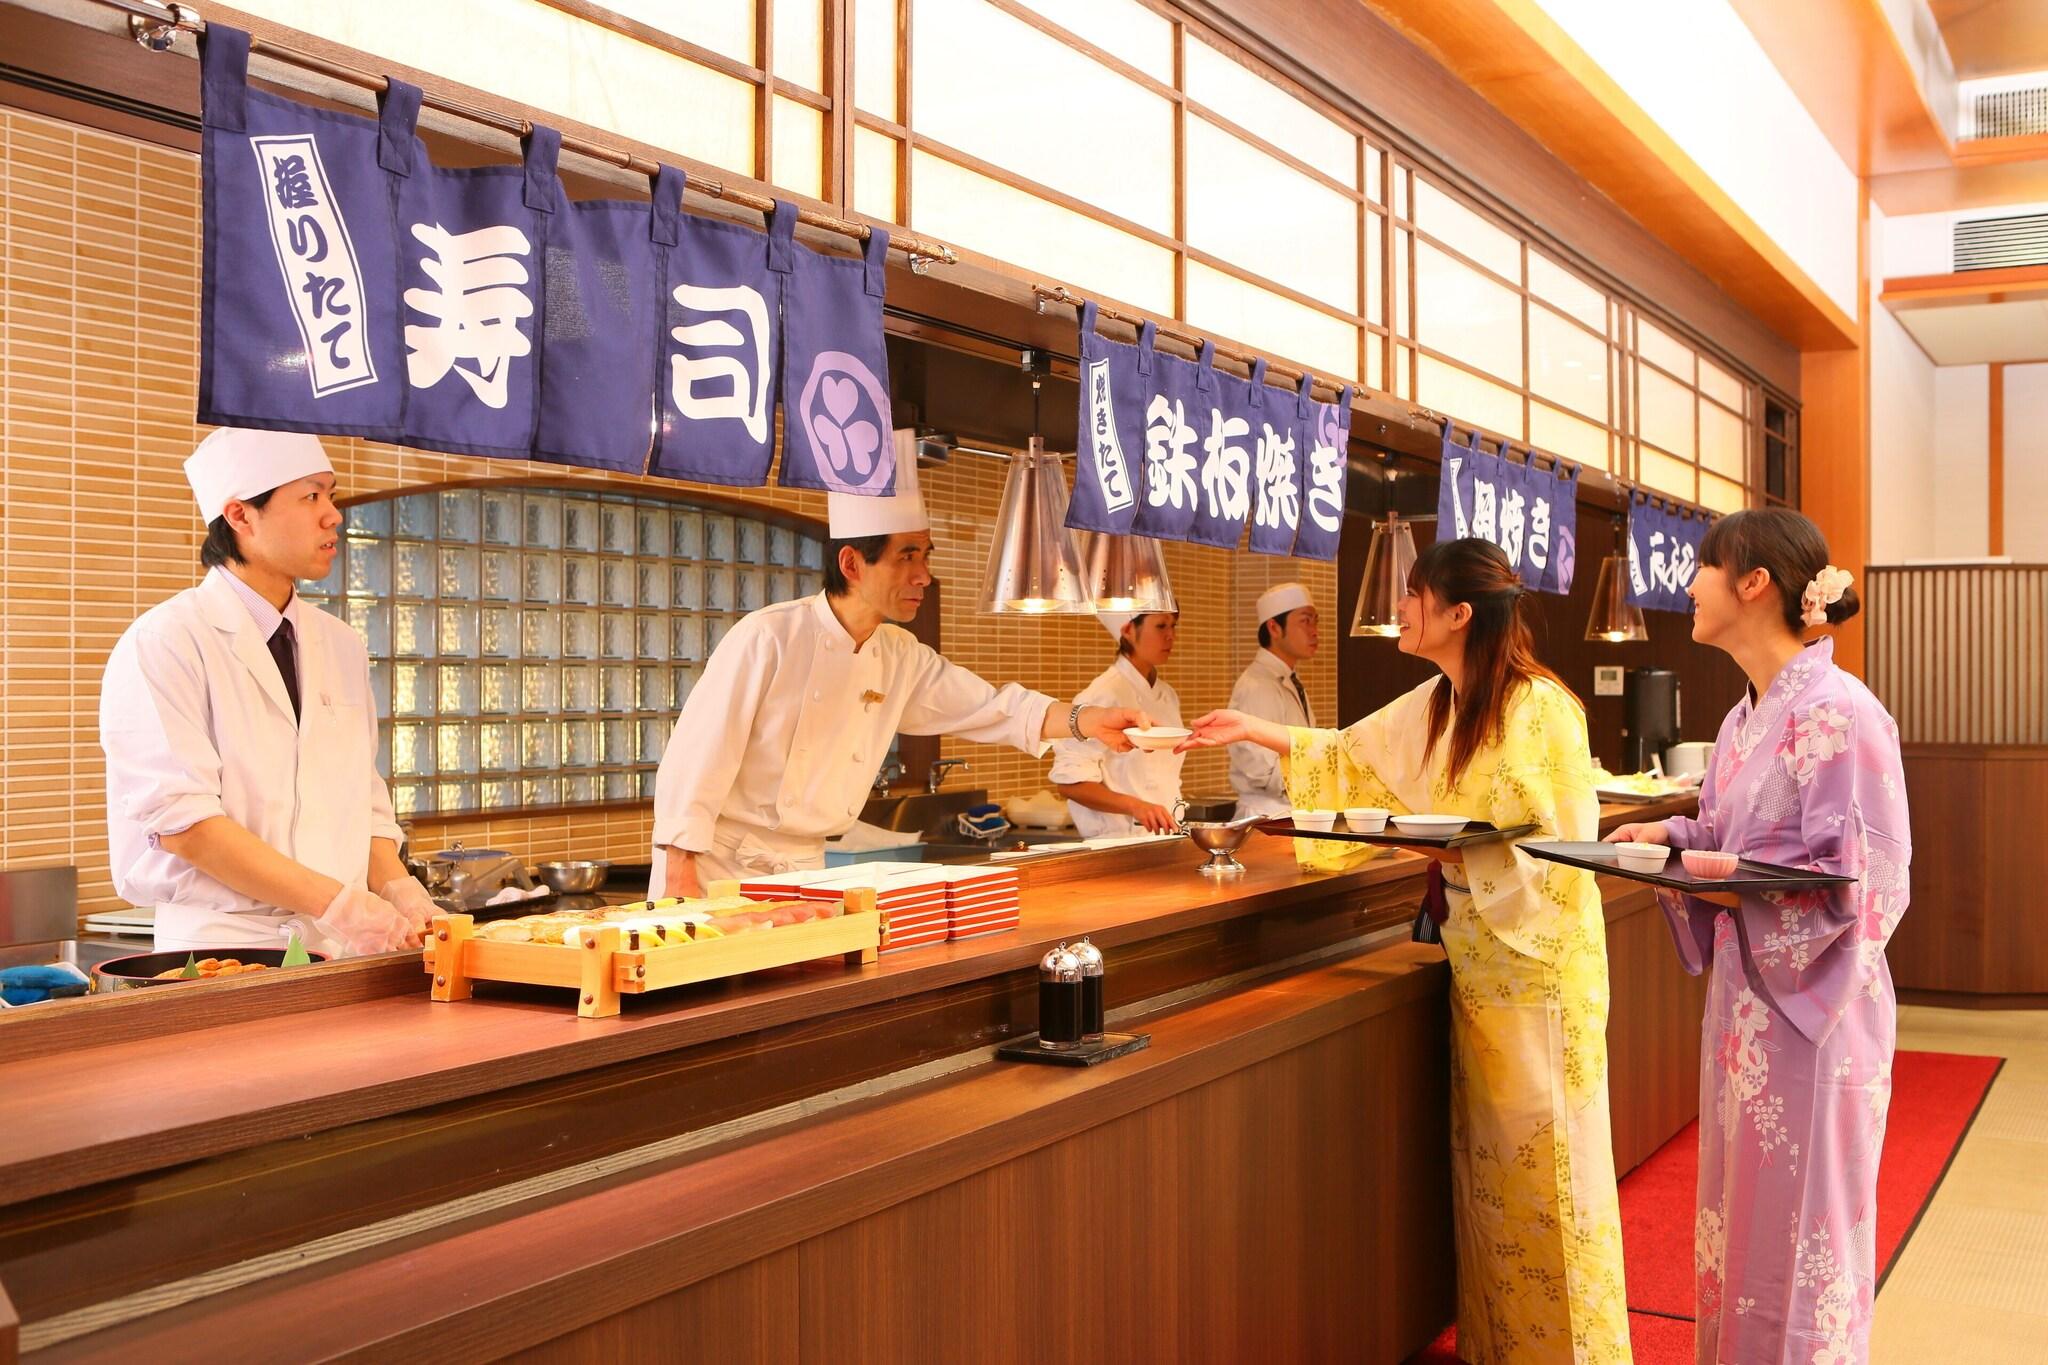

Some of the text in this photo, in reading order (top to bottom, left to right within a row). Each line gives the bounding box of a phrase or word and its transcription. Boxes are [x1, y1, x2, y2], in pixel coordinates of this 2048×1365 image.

[272, 154, 352, 370] 握りたて
[404, 221, 771, 446] 寿司
[1095, 372, 1123, 498] 焼きたて
[1146, 394, 1343, 533] 鉄板焼き
